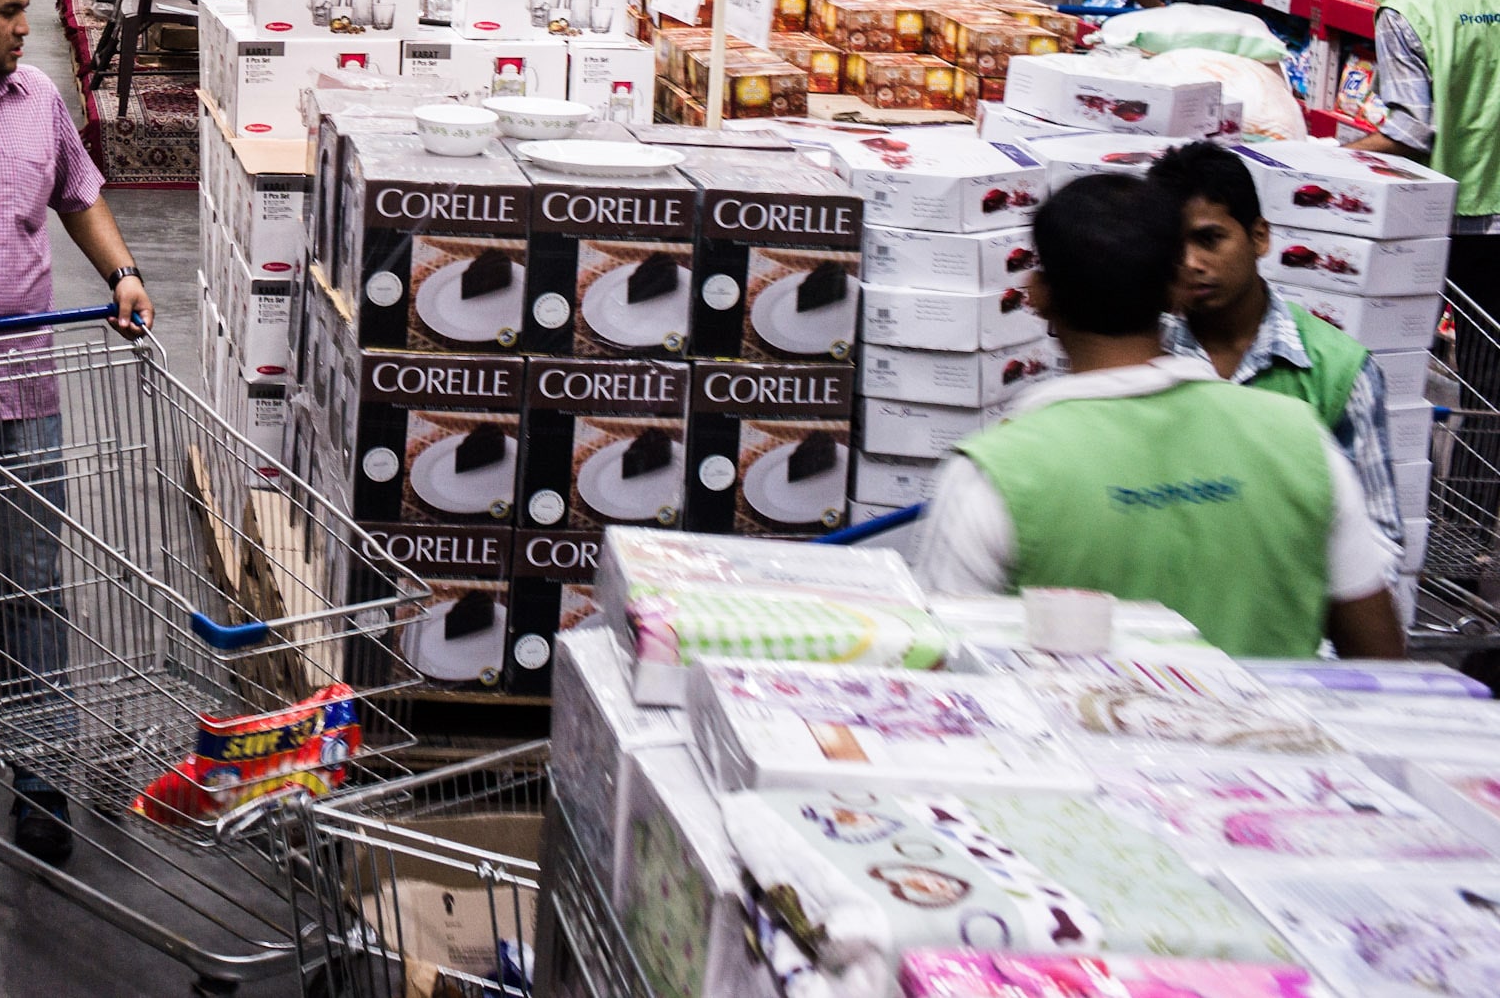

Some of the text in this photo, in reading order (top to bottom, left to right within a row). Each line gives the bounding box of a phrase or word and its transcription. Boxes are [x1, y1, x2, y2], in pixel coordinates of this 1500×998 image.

[245, 47, 273, 56] KARAT
[411, 50, 440, 59] KARAT
[375, 187, 515, 222] CORELLE
[541, 191, 681, 226] CORELLE
[712, 199, 852, 234] CORELLE
[371, 363, 509, 397] CORELLE
[538, 369, 674, 402] CORELLE
[703, 371, 839, 404] CORELLE
[362, 531, 498, 565] CORELLE
